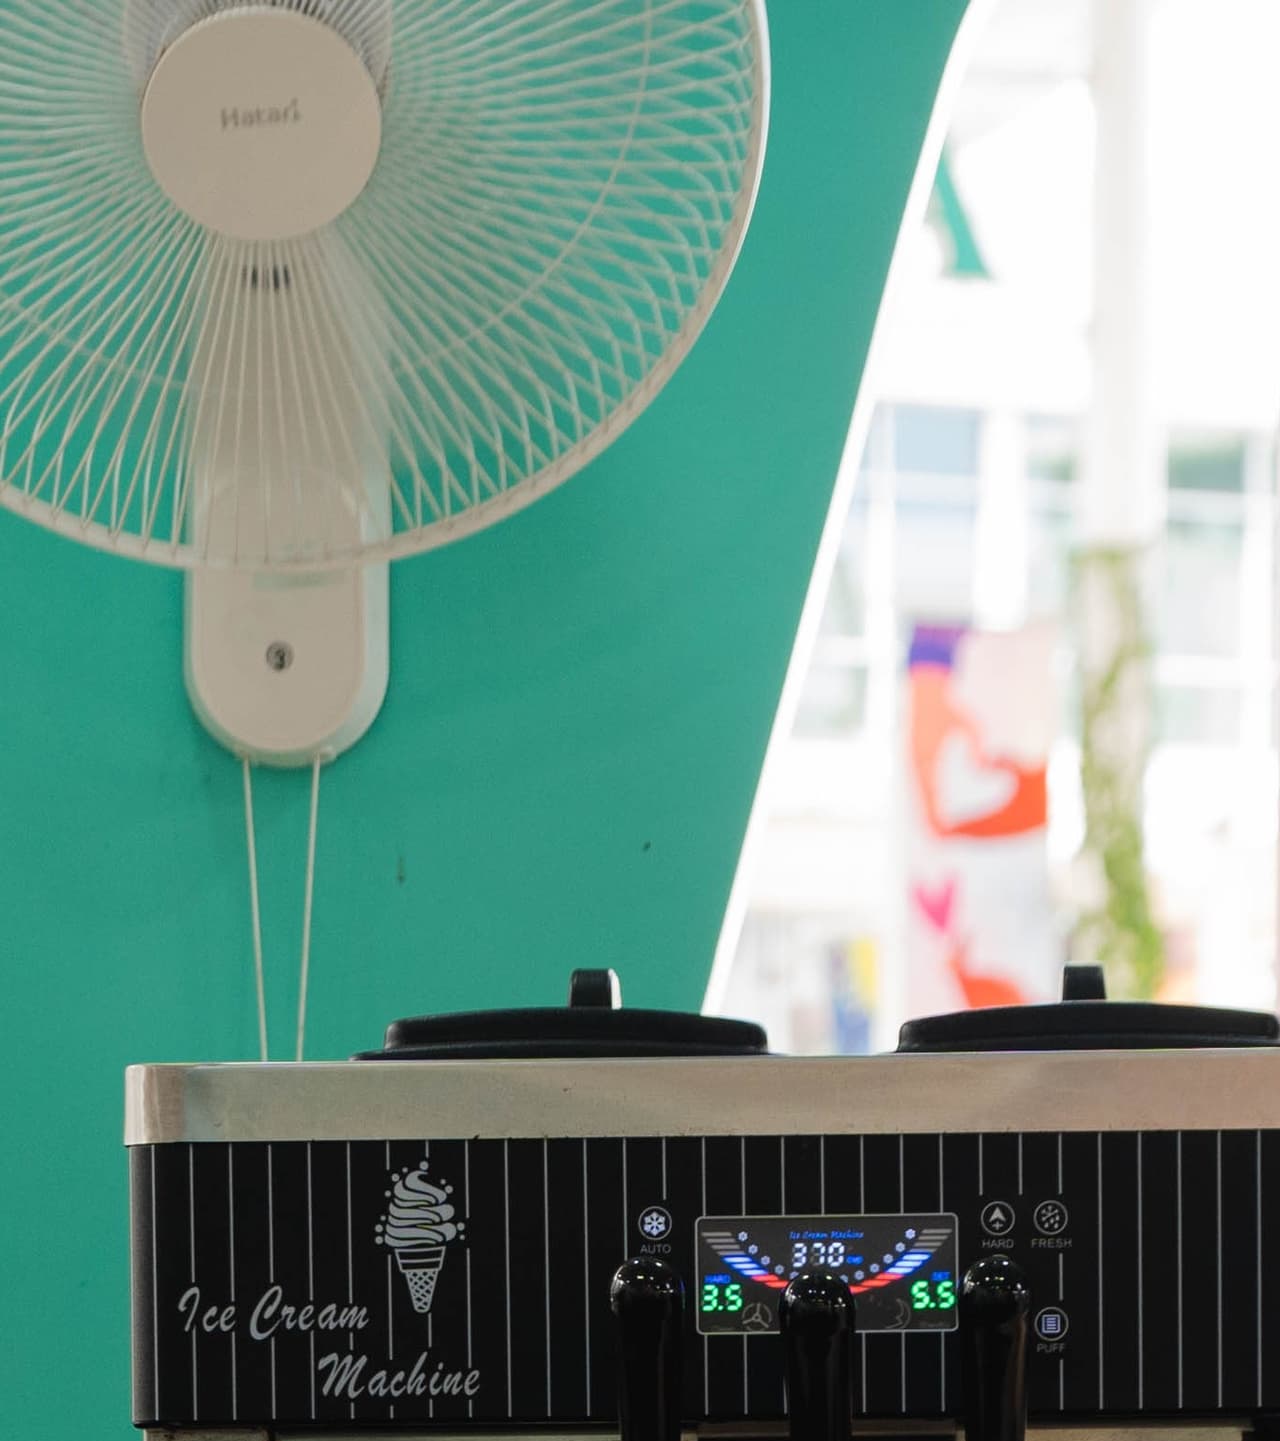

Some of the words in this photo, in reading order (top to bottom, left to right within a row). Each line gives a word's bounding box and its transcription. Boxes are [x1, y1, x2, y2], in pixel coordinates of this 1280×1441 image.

[640, 1243, 672, 1254] AUTO
[792, 1242, 846, 1268] 370
[982, 1238, 1015, 1249] HARD
[1031, 1238, 1073, 1249] FRESH
[702, 1283, 744, 1312] 3.5
[910, 1280, 957, 1310] 5.5
[178, 1286, 236, 1332] Ice
[250, 1285, 369, 1341] Cream
[1037, 1343, 1066, 1353] PUFF
[318, 1352, 480, 1399] Machine
